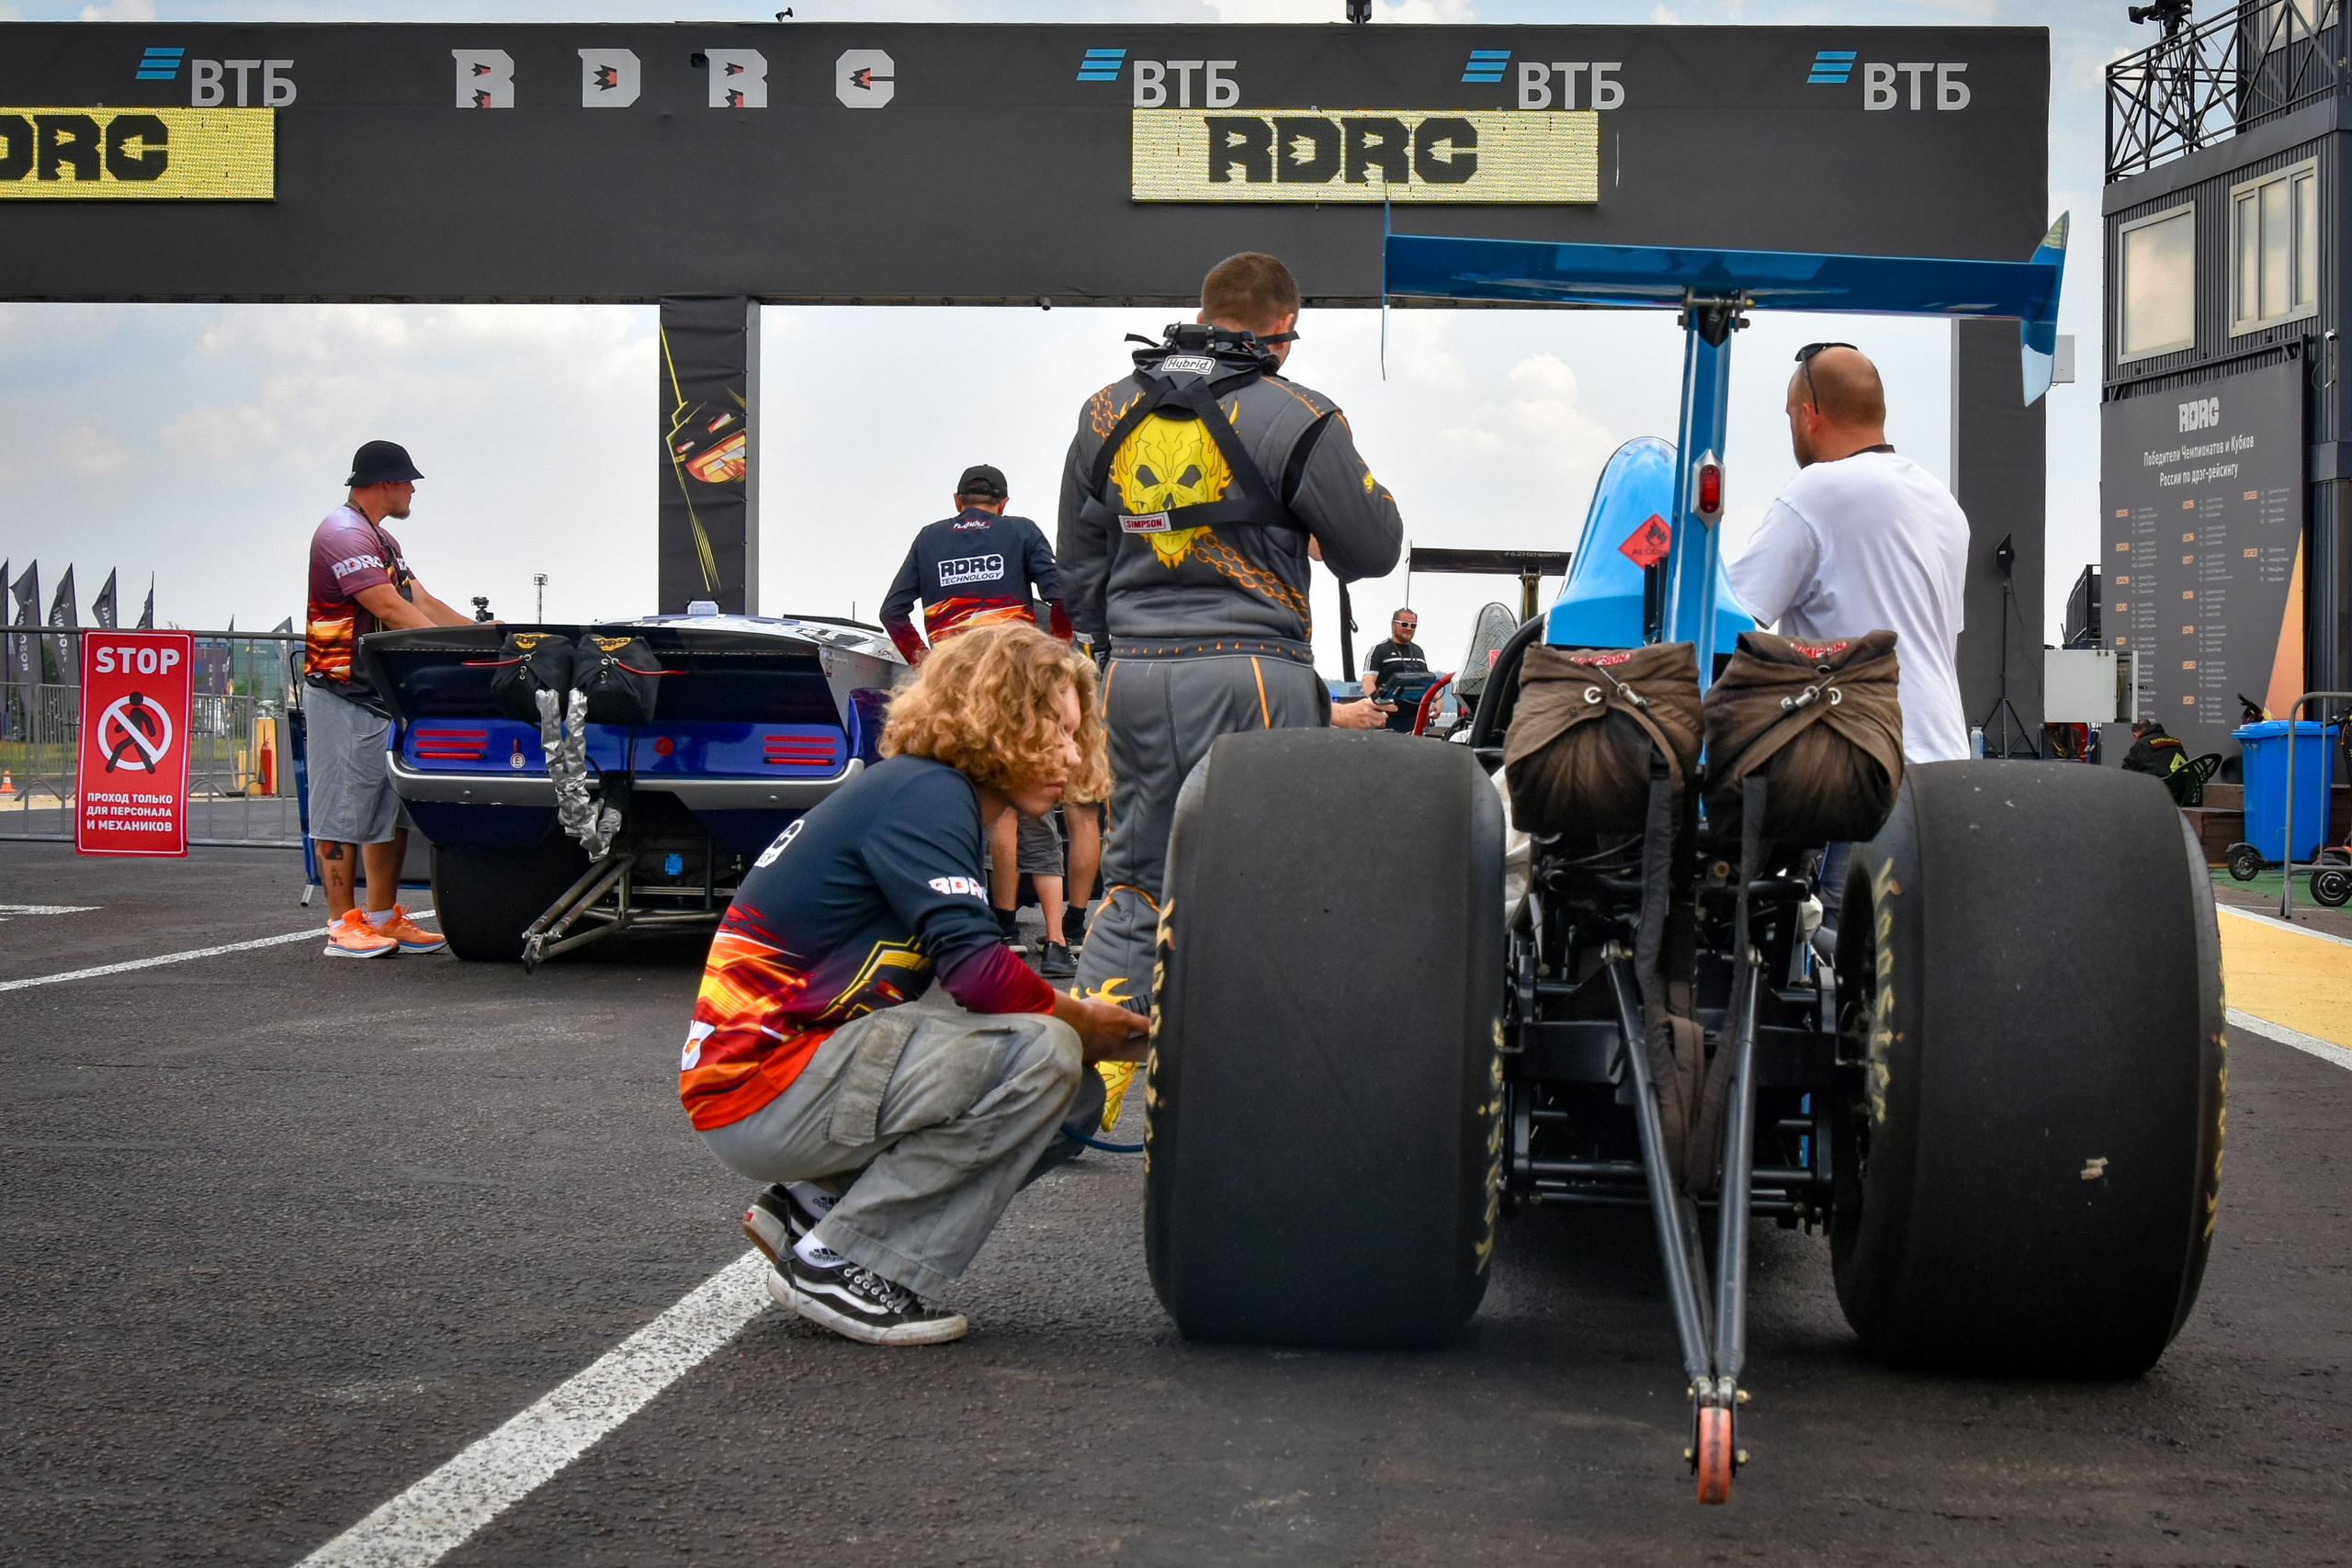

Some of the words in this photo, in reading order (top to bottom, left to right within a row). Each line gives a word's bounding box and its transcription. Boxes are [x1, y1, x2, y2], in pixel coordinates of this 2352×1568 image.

[192, 60, 296, 107] ВТБ
[1134, 61, 1239, 108] ВТБ
[1519, 62, 1624, 109] ВТБ
[1864, 63, 1970, 111] ВТБ
[1204, 117, 1477, 184] RDRC
[1167, 359, 1209, 370] Hybrid
[2178, 397, 2220, 433] RDRC
[2143, 450, 2181, 467] Победители
[2181, 442, 2224, 459] Чемпионатов
[2224, 441, 2230, 452] и
[2231, 434, 2255, 455] Кубков
[2159, 471, 2182, 487] России
[2182, 471, 2190, 483] по
[2191, 462, 2239, 485] дрэг-рейсингу
[1125, 518, 1163, 528] SIMPSON
[940, 556, 1002, 578] RDRC
[941, 571, 1002, 586] TECHNOLOGY
[96, 647, 180, 674] STOP
[86, 806, 107, 816] ДЛЯ
[110, 807, 173, 817] ПЕРСОНАЛА
[87, 793, 130, 804] ПРОХОД
[131, 794, 173, 804] ТОЛЬКО
[86, 819, 95, 829] И
[98, 820, 173, 832] МЕХАНИКОВ
